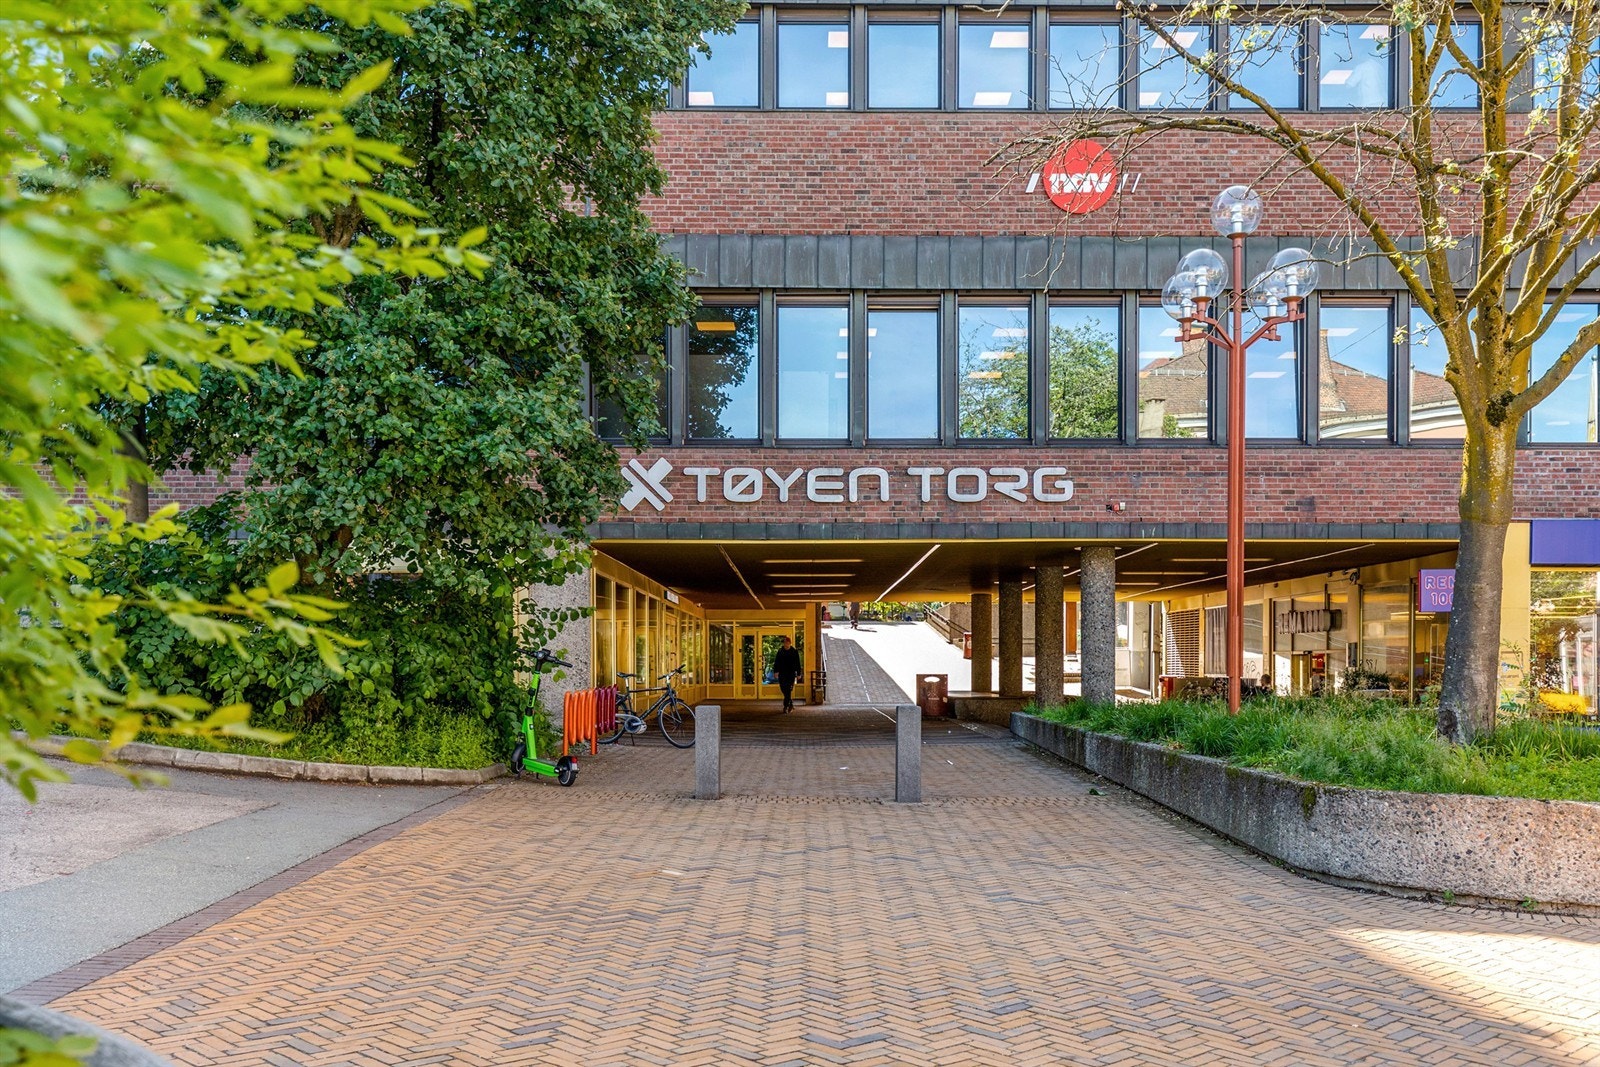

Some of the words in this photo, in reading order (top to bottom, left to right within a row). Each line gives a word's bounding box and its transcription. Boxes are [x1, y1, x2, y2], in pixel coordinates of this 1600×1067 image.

[1049, 172, 1113, 194] nav
[683, 467, 890, 503] TØYEN
[907, 467, 1074, 503] TORG
